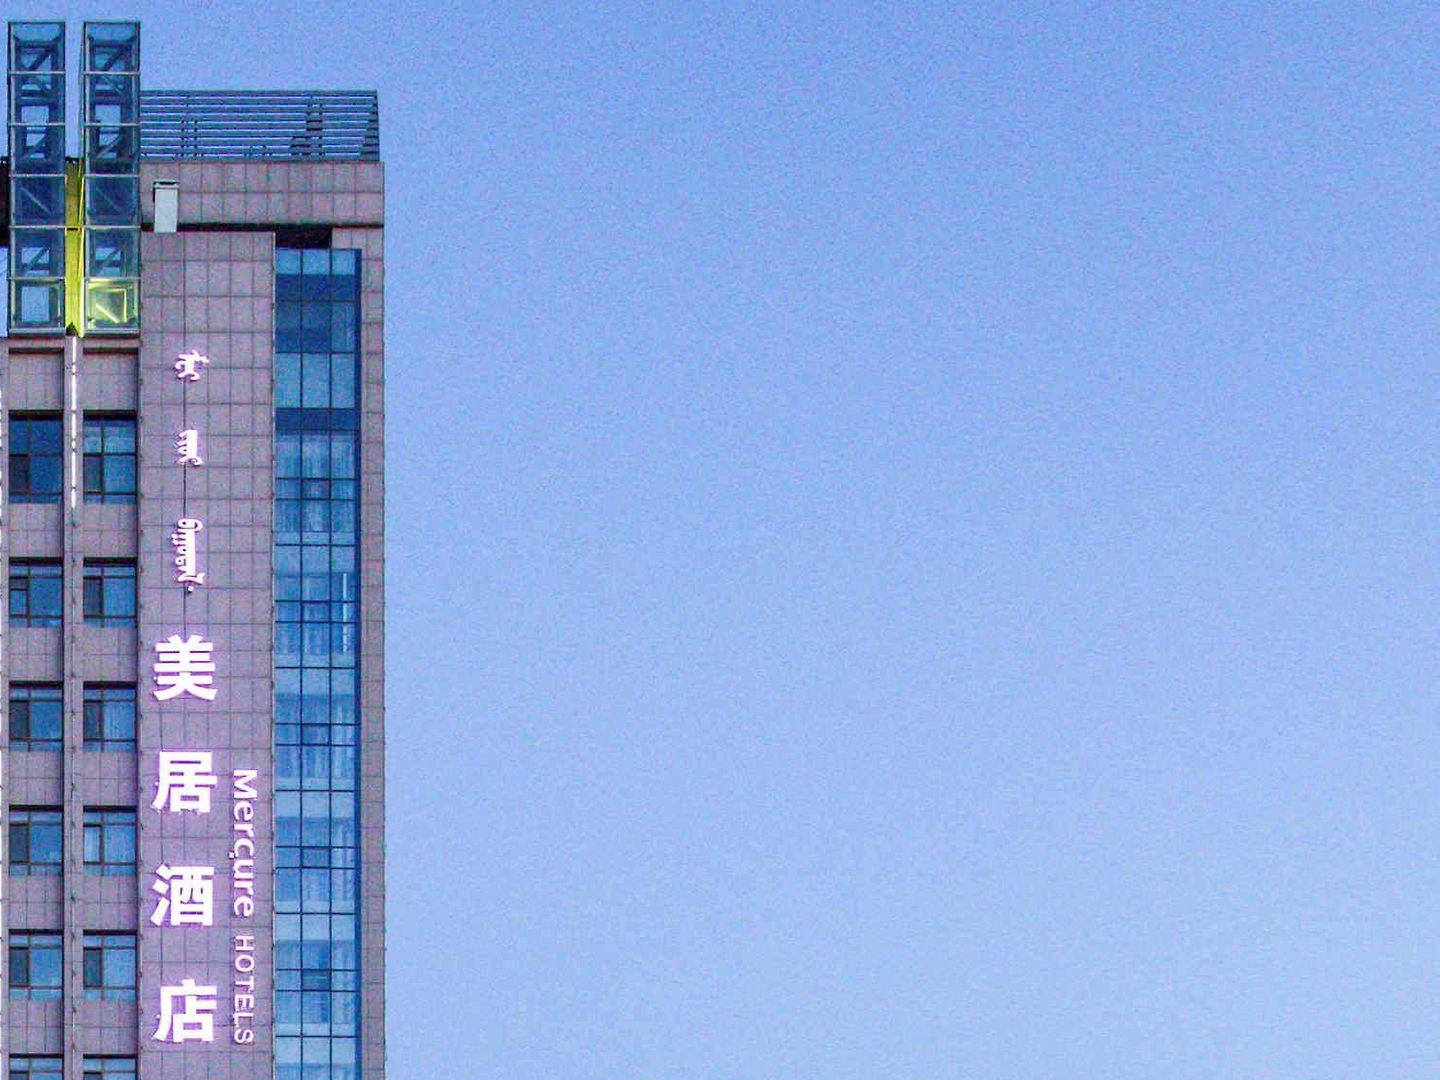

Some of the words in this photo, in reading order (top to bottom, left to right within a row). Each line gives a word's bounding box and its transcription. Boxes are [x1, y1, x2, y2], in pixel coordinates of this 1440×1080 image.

[150, 634, 219, 1043] 美居酒店
[233, 769, 258, 919] Mercure
[234, 935, 255, 1045] HOTELS
